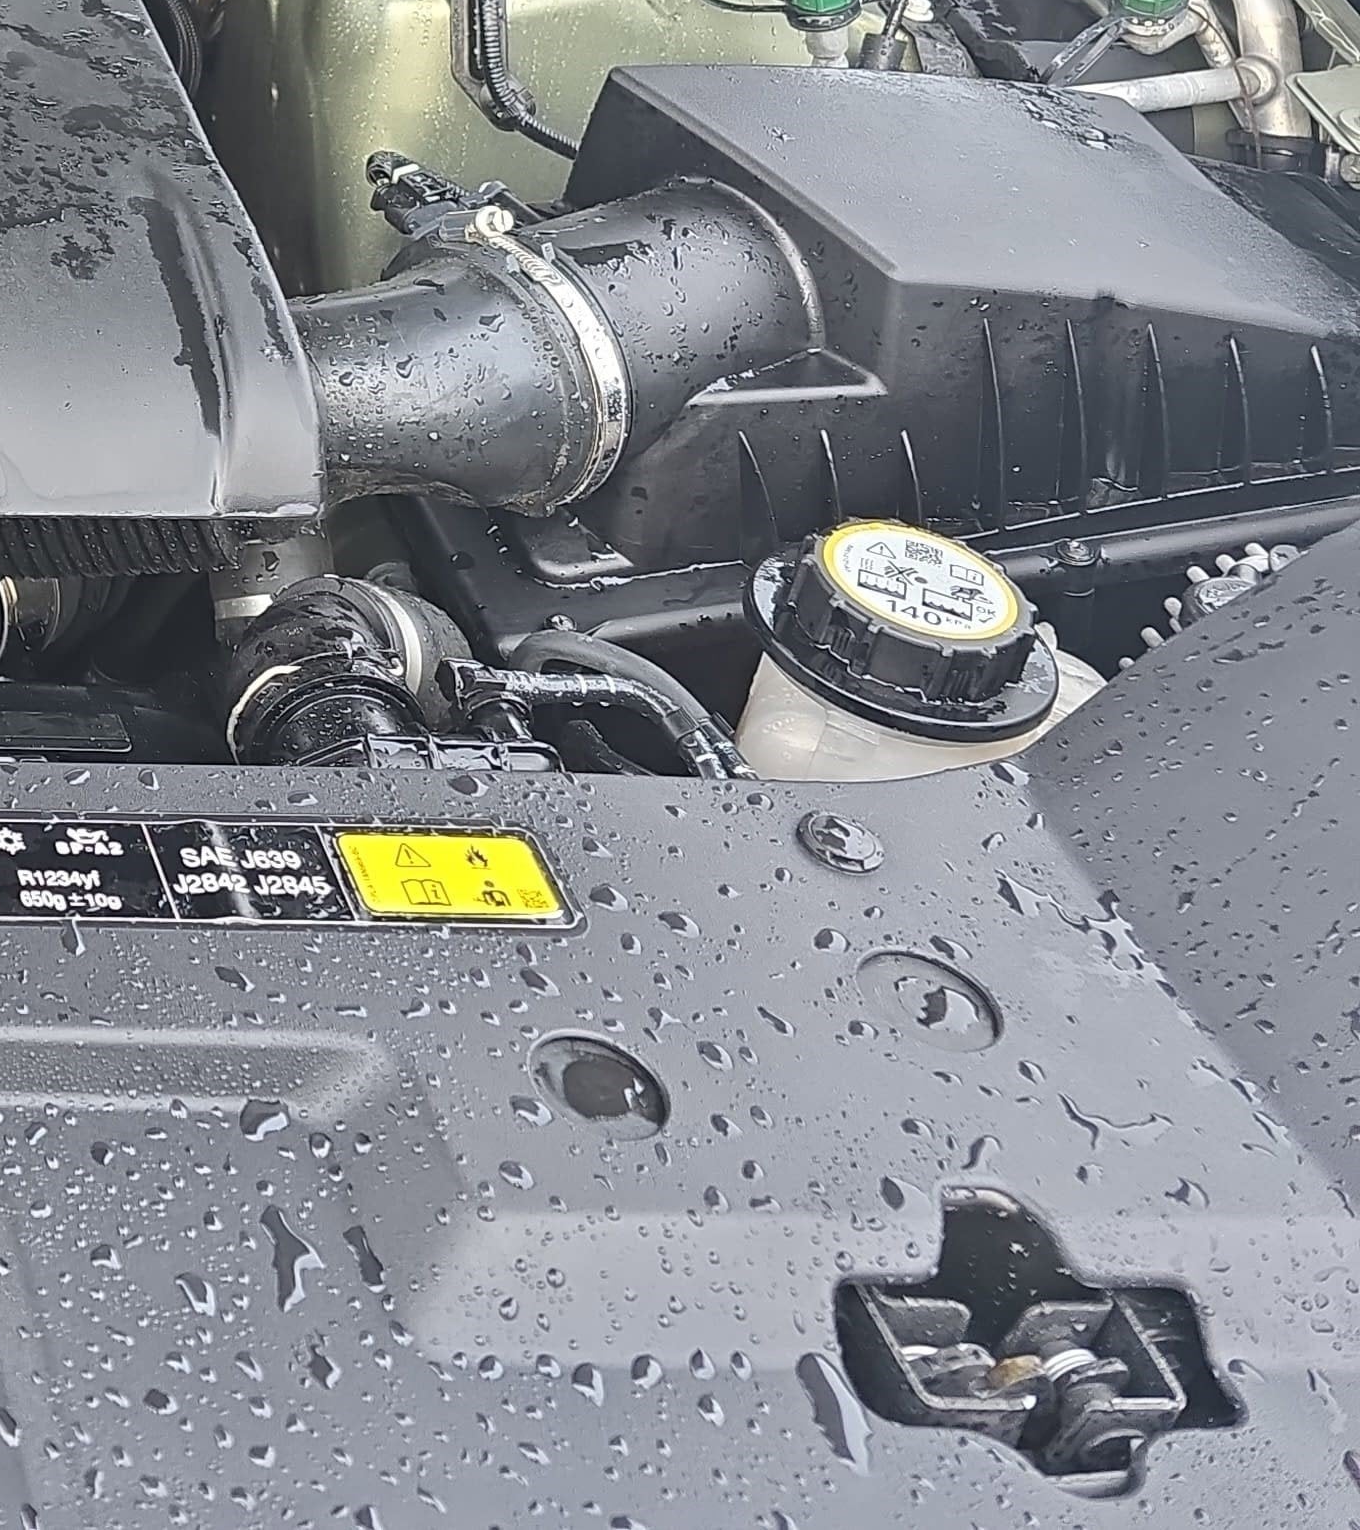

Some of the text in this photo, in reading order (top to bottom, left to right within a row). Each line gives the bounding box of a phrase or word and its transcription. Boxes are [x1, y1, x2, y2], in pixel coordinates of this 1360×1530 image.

[885, 599, 942, 626] 140
[976, 605, 996, 618] OK
[180, 846, 302, 870] SAE J639
[16, 869, 101, 890] R1234yf
[173, 873, 330, 896] J2842 J2845
[19, 890, 67, 911] 650g
